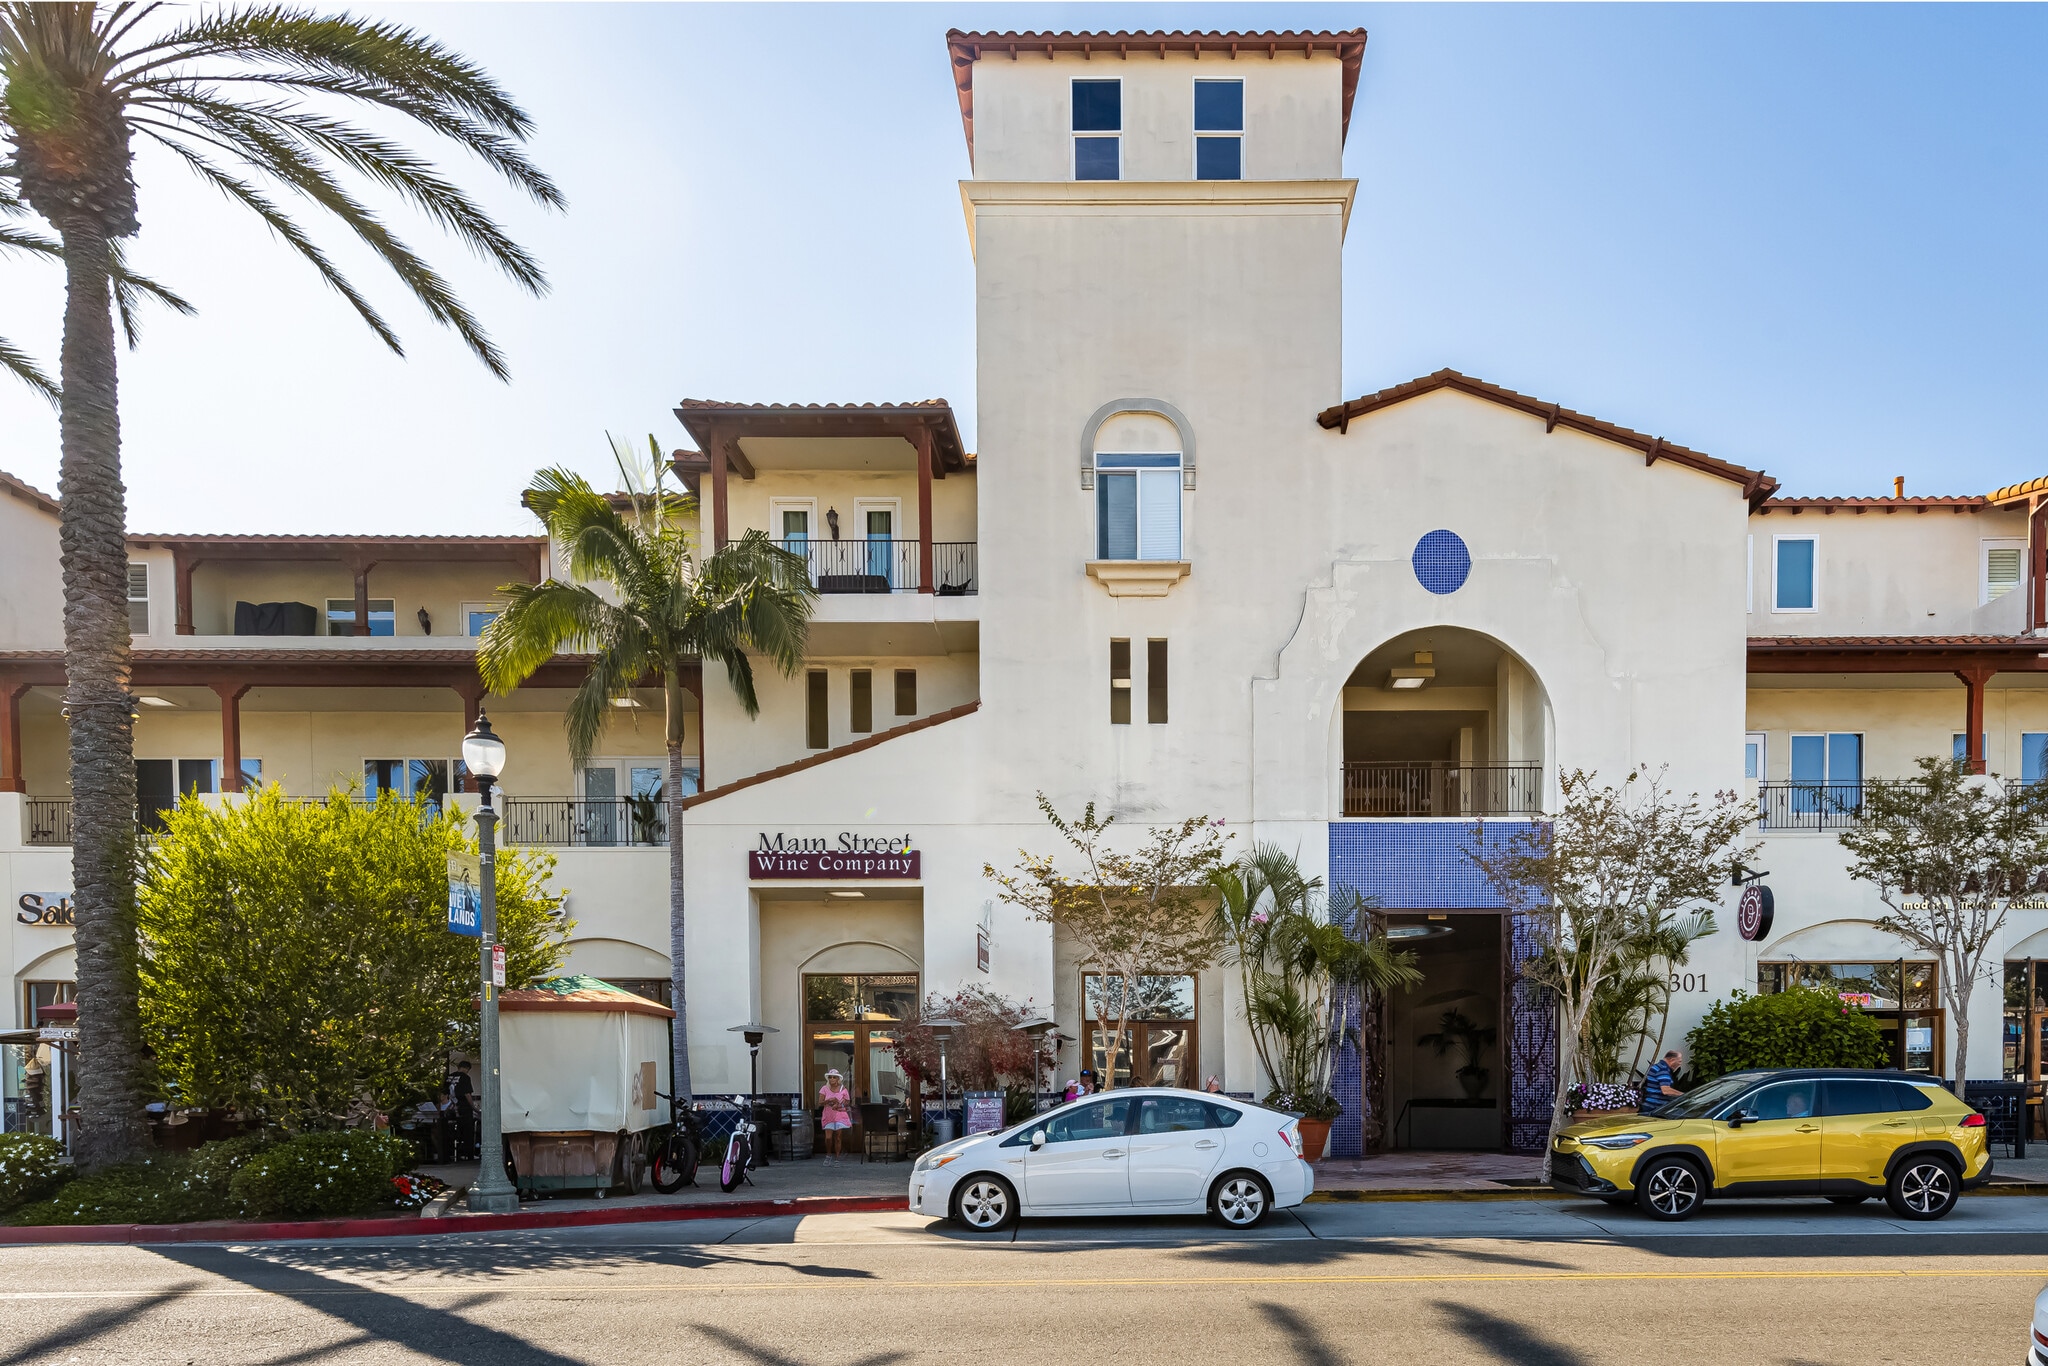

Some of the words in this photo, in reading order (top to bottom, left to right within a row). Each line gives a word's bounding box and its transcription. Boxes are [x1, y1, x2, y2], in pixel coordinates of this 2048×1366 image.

[757, 832, 827, 855] Main
[838, 832, 912, 855] Street
[757, 856, 809, 871] Wine
[818, 856, 912, 874] Company
[449, 892, 466, 908] WET
[449, 908, 475, 926] LANDS
[1670, 973, 1709, 993] 301
[853, 1005, 871, 1015] 105
